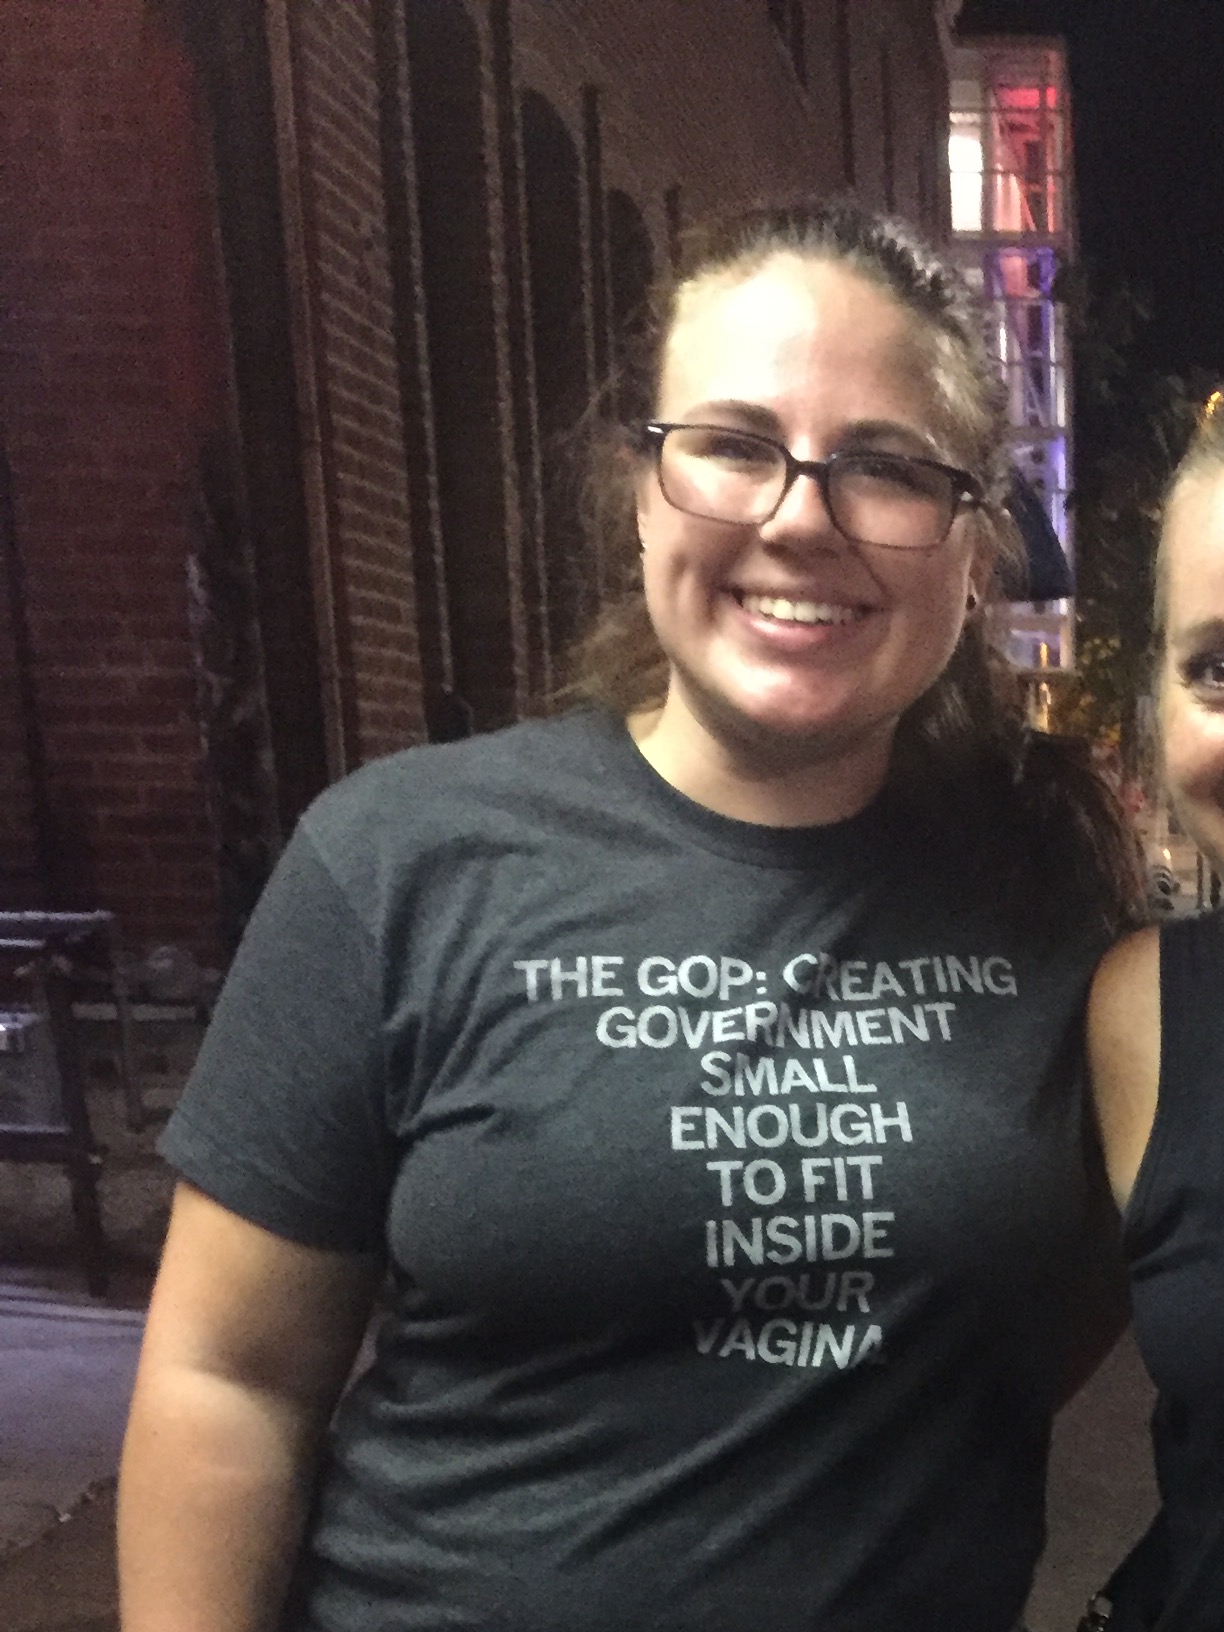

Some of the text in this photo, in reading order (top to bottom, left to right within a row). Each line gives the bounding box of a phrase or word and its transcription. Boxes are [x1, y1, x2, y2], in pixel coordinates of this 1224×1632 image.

[514, 953, 1019, 1001] THE GOP: CREATING
[595, 1001, 957, 1049] GOVERNMENT
[701, 1051, 878, 1097] SMALL
[670, 1101, 914, 1151] ENOUGH
[706, 1155, 883, 1207] TO FIT
[705, 1211, 896, 1267] INSIDE
[720, 1270, 876, 1313] YOUR
